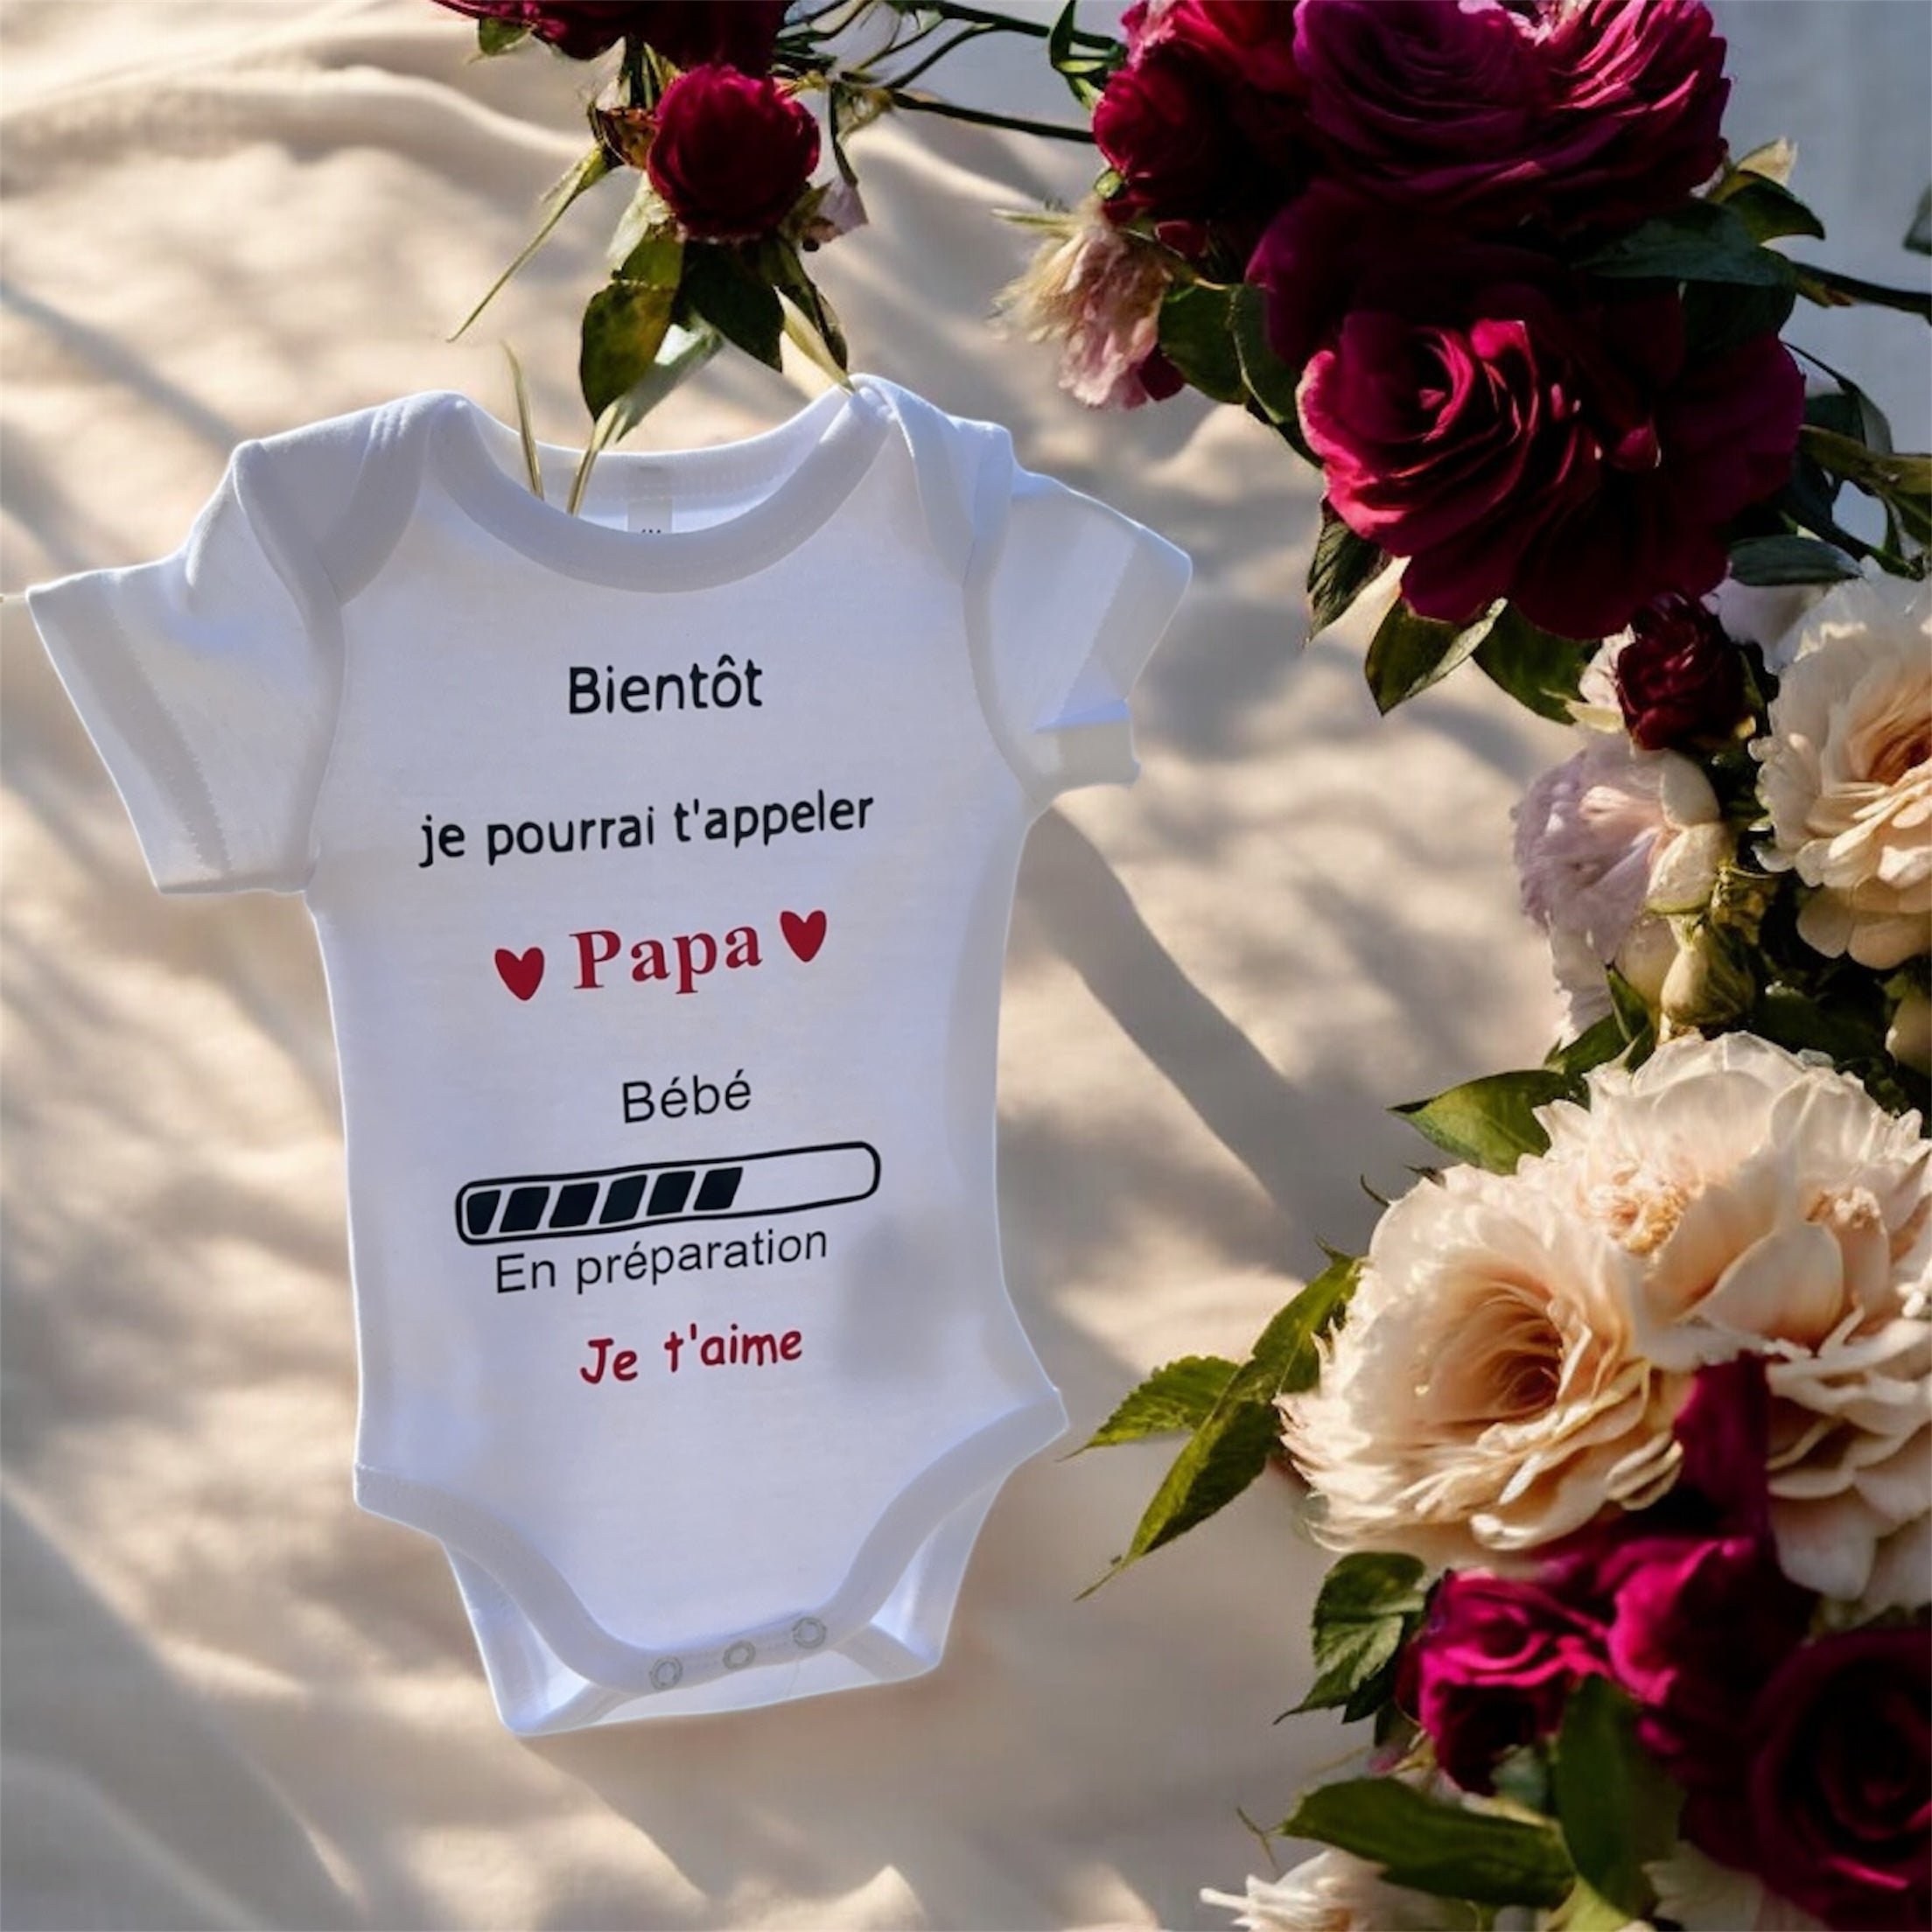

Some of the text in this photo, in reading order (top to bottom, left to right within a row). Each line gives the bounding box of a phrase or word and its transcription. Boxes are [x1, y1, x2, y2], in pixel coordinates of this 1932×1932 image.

[569, 654, 763, 715] Bientôt
[418, 788, 874, 869] je pourrai t'appeler
[569, 926, 763, 995] Papa
[622, 1068, 752, 1124] Bébé
[496, 1228, 827, 1295] En préparation
[579, 1323, 802, 1385] Je t'aime
